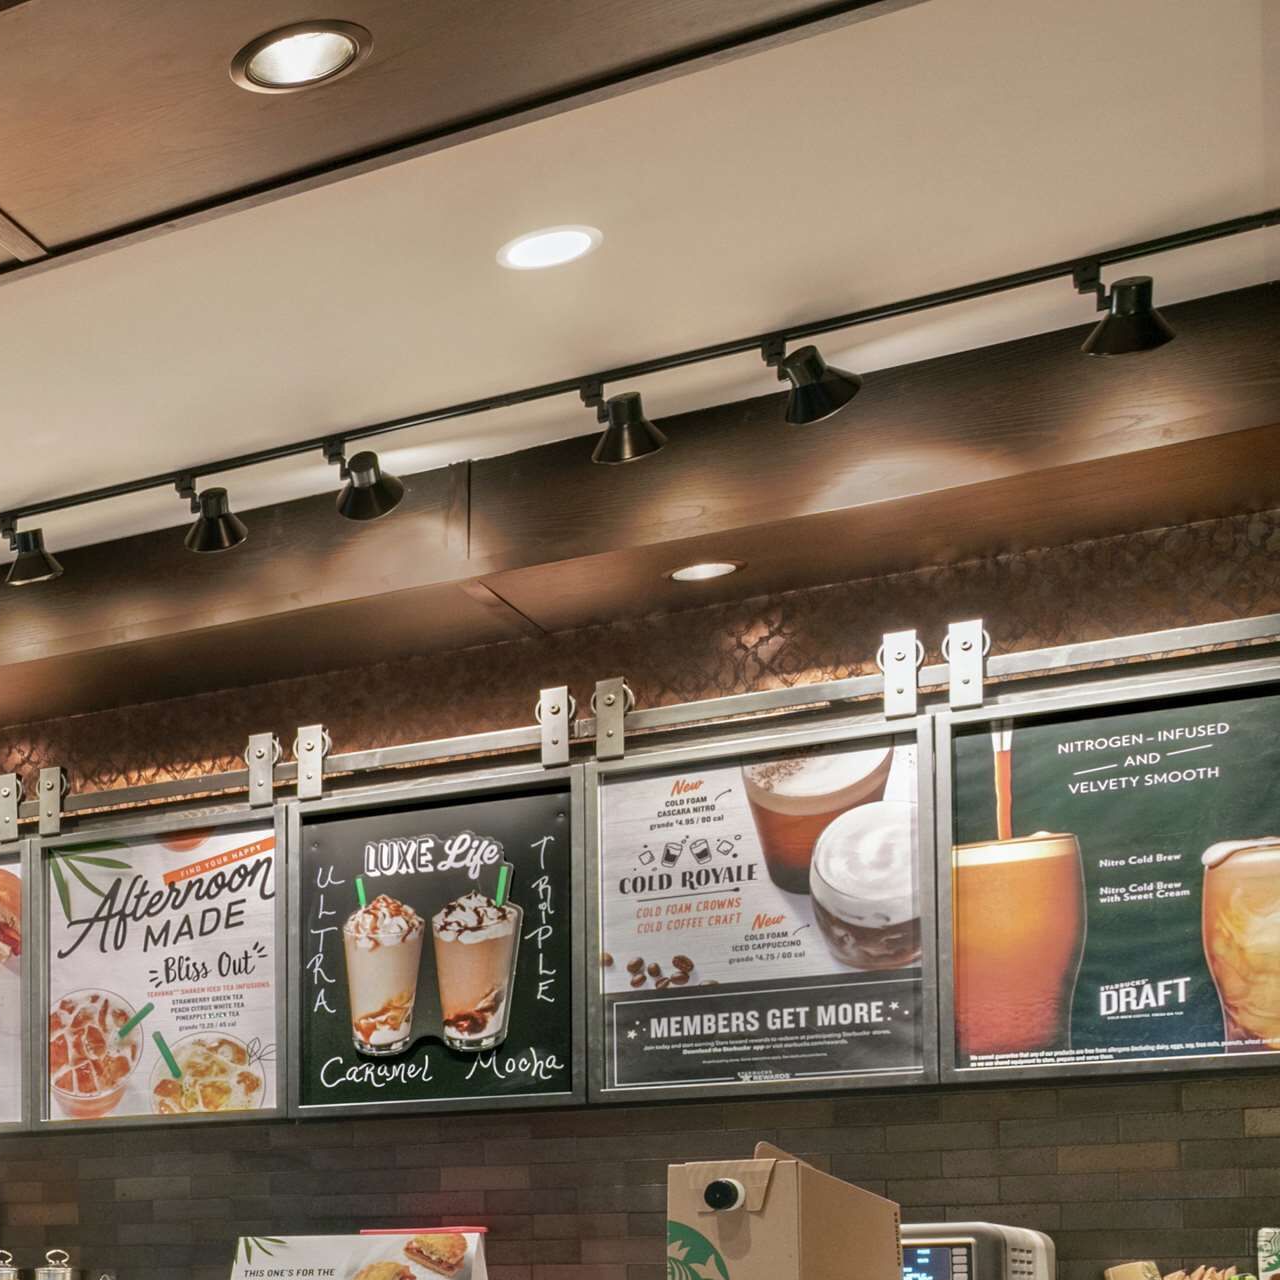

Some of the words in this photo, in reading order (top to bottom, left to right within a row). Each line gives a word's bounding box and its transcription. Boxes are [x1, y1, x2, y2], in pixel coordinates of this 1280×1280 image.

[1124, 752, 1160, 768] AND
[671, 779, 704, 797] New
[1068, 776, 1139, 795] VELVETY
[1144, 767, 1220, 786] SMOOTH
[658, 808, 691, 818] CASCARA
[693, 805, 715, 813] NITRO
[665, 799, 684, 807] COLD
[686, 797, 707, 805] FOAM
[205, 856, 228, 870] YOUR
[232, 844, 262, 862] HAPPY
[364, 837, 434, 878] LUXE
[436, 833, 501, 880] Life
[1099, 859, 1125, 868] Nitro
[1128, 855, 1153, 865] Cold
[1156, 853, 1181, 863] Brew
[619, 873, 672, 895] COLD
[682, 864, 758, 890] ROYALE
[1099, 886, 1125, 895] Nitro
[1130, 883, 1154, 893] Cold
[1157, 881, 1182, 890] Brew
[1100, 894, 1120, 903] with
[1123, 892, 1153, 902] Sweet
[1156, 889, 1190, 898] Cream
[58, 856, 275, 959] Afternoon
[637, 907, 661, 919] COLD
[666, 903, 691, 915] FOAM
[696, 898, 741, 912] CROWNS
[143, 898, 246, 952] MADE
[637, 922, 662, 934] COLD
[667, 917, 704, 930] COFFEE
[708, 913, 743, 926] CRAFT
[752, 912, 785, 930] New
[752, 940, 801, 950] CAPPUCCINO
[767, 931, 788, 939] FOAM
[164, 952, 212, 984] Bliss
[218, 950, 256, 978] Out
[1100, 977, 1191, 1016] DRAFT
[650, 1010, 760, 1039] MEMBERS
[767, 1007, 809, 1030] GET
[817, 1002, 883, 1027] MORE
[465, 1047, 564, 1079] Mocha
[244, 1269, 265, 1278] THIS
[267, 1269, 294, 1277] ONE'S
[318, 1268, 335, 1276] THE
